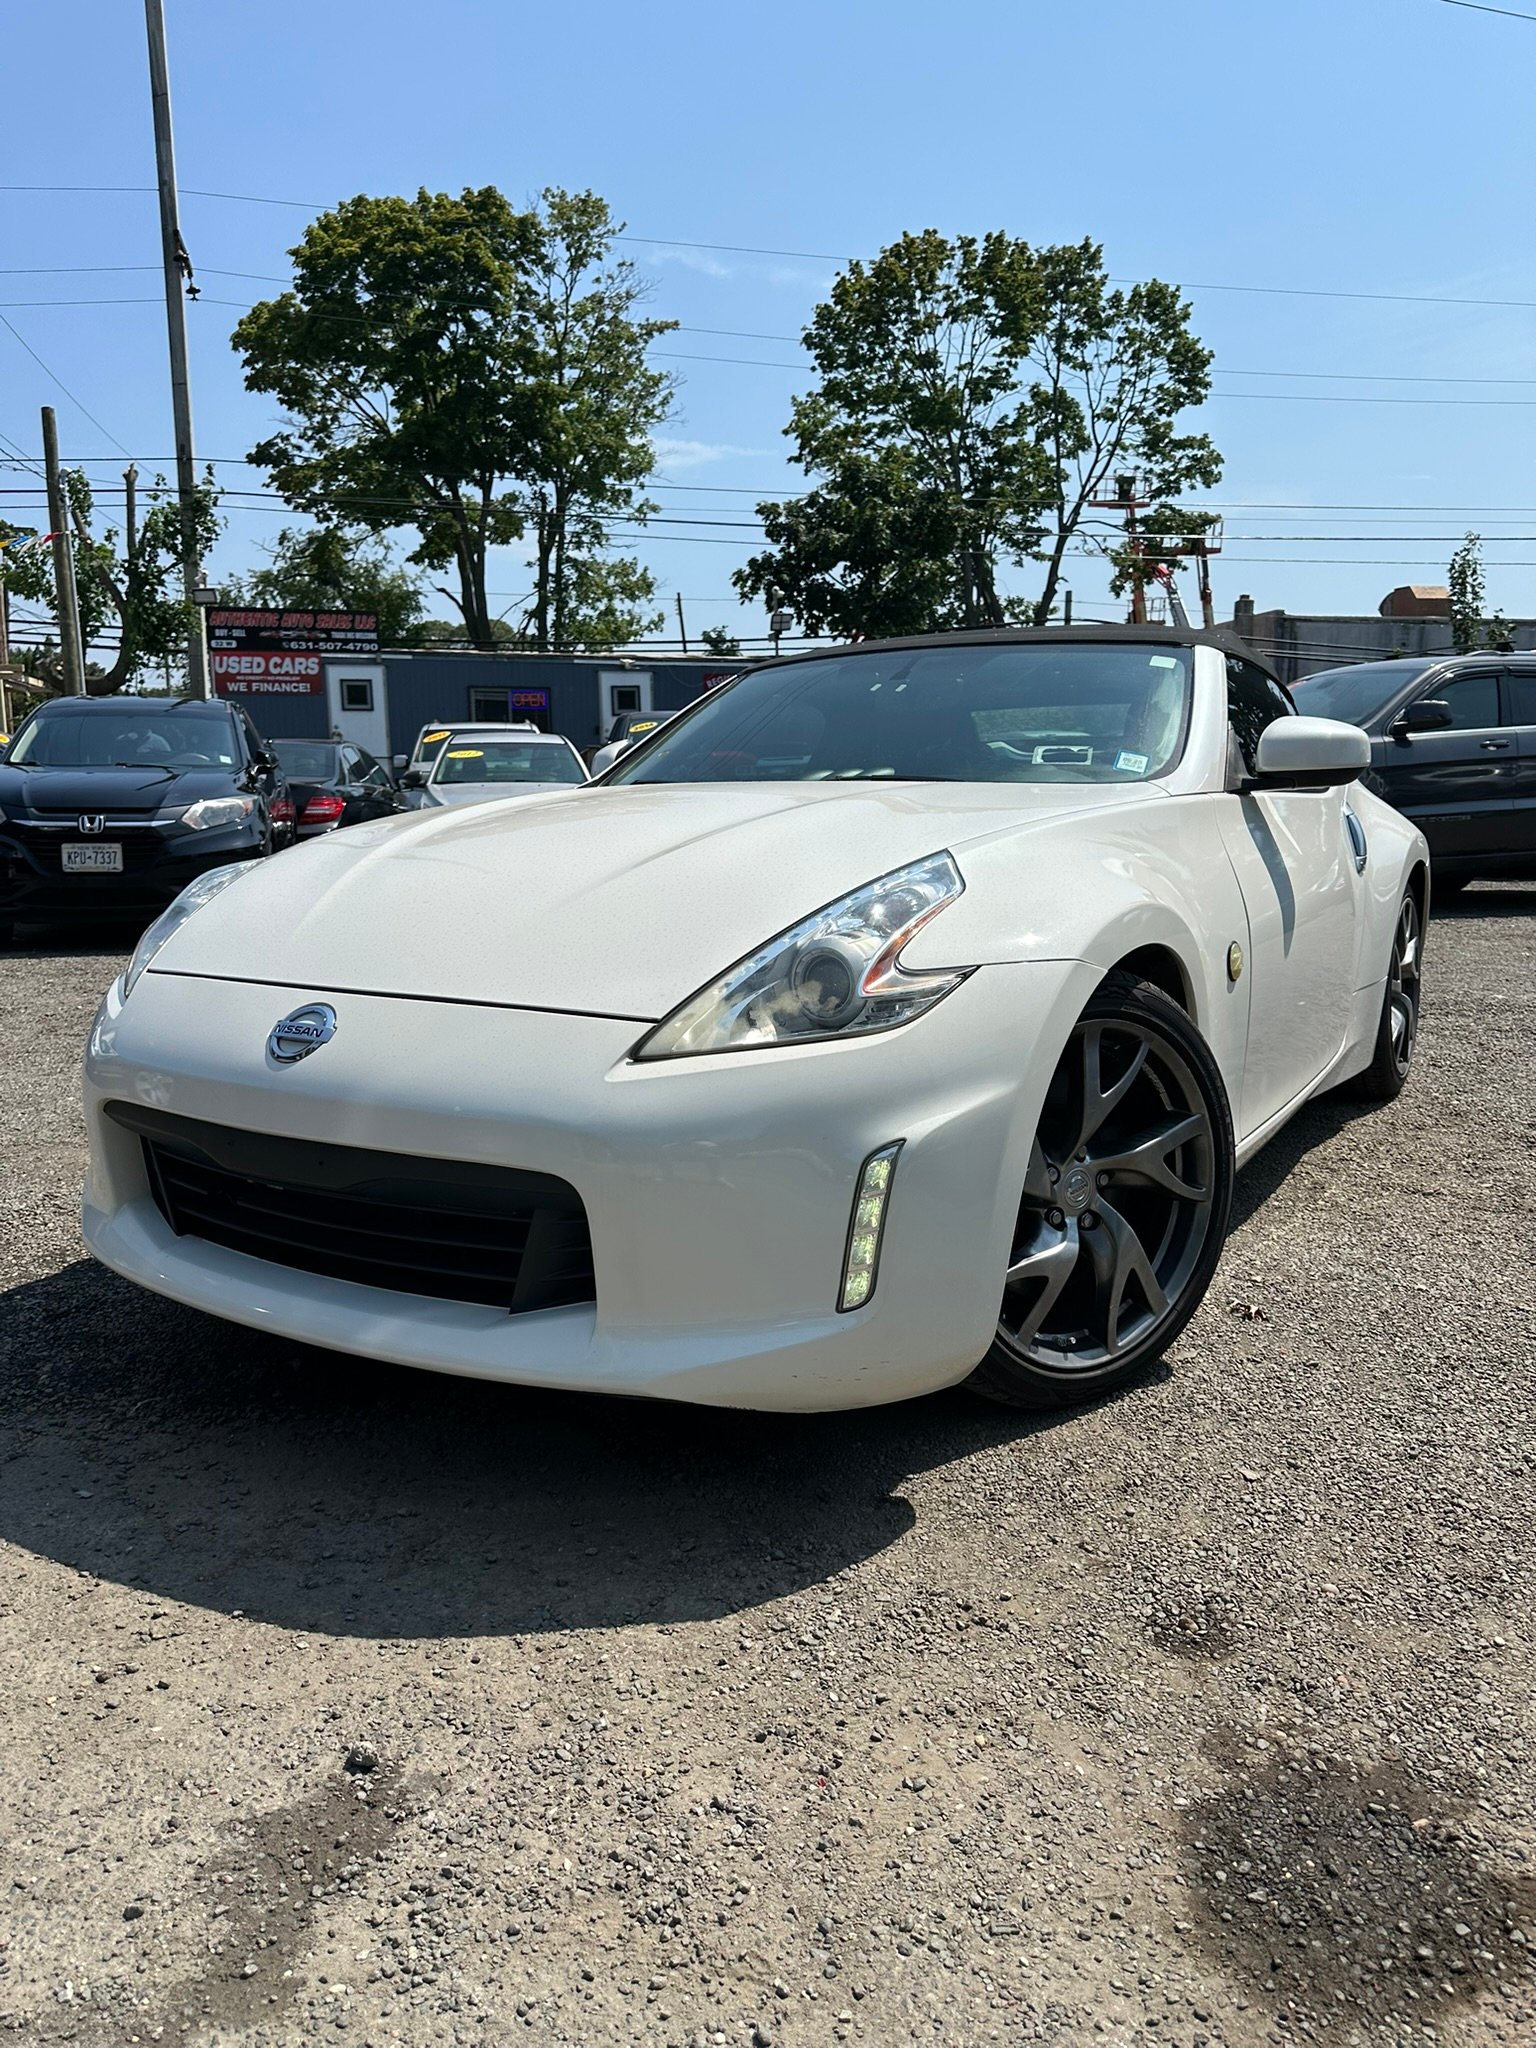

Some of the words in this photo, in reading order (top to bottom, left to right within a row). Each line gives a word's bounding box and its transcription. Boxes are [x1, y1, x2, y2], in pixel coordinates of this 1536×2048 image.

[210, 612, 280, 627] AUTHENTIC
[282, 613, 314, 628] AUTO
[316, 614, 353, 630] SALES
[355, 615, 377, 630] LLC
[290, 641, 379, 651] 631-507-4790
[215, 656, 265, 673] USED
[269, 657, 320, 675] CARS
[226, 682, 248, 692] WE
[251, 682, 311, 692] FINANCE!
[512, 692, 545, 707] OPEN
[275, 1025, 323, 1037] NISSAN
